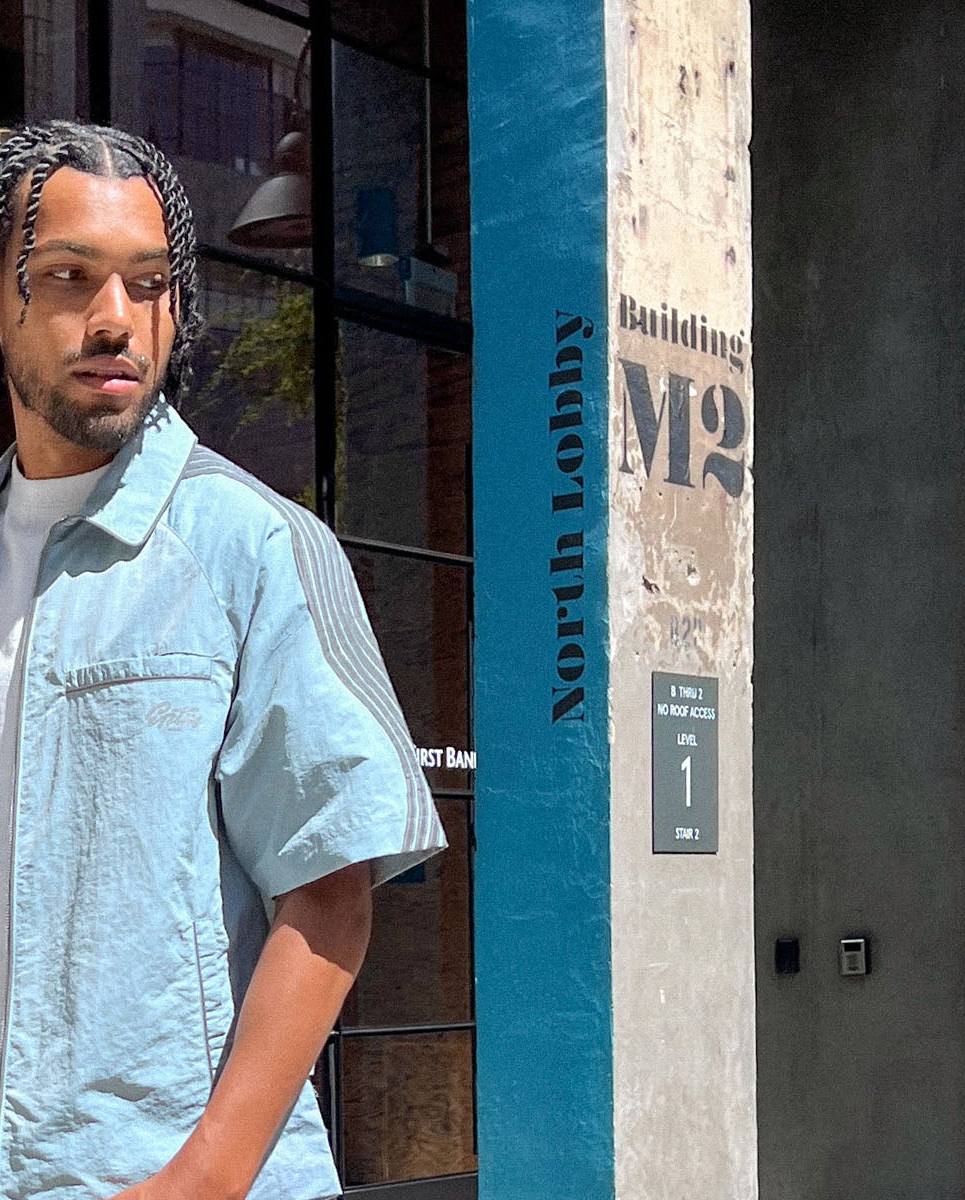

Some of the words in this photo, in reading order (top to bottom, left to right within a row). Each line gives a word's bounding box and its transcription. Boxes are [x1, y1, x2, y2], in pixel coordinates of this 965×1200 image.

[620, 293, 744, 374] Building
[549, 310, 593, 514] Lobby
[618, 357, 745, 499] M2
[549, 529, 585, 724] North
[657, 703, 669, 716] NO
[670, 704, 689, 717] ROOF
[690, 707, 716, 720] ACCESS
[679, 686, 697, 699] THRU
[698, 688, 703, 700] 2
[414, 745, 443, 768] IRST
[446, 746, 477, 769] BAN
[677, 733, 698, 747] LEVEL
[681, 755, 692, 808] 1
[675, 827, 693, 840] STAIR
[694, 829, 700, 840] 2
